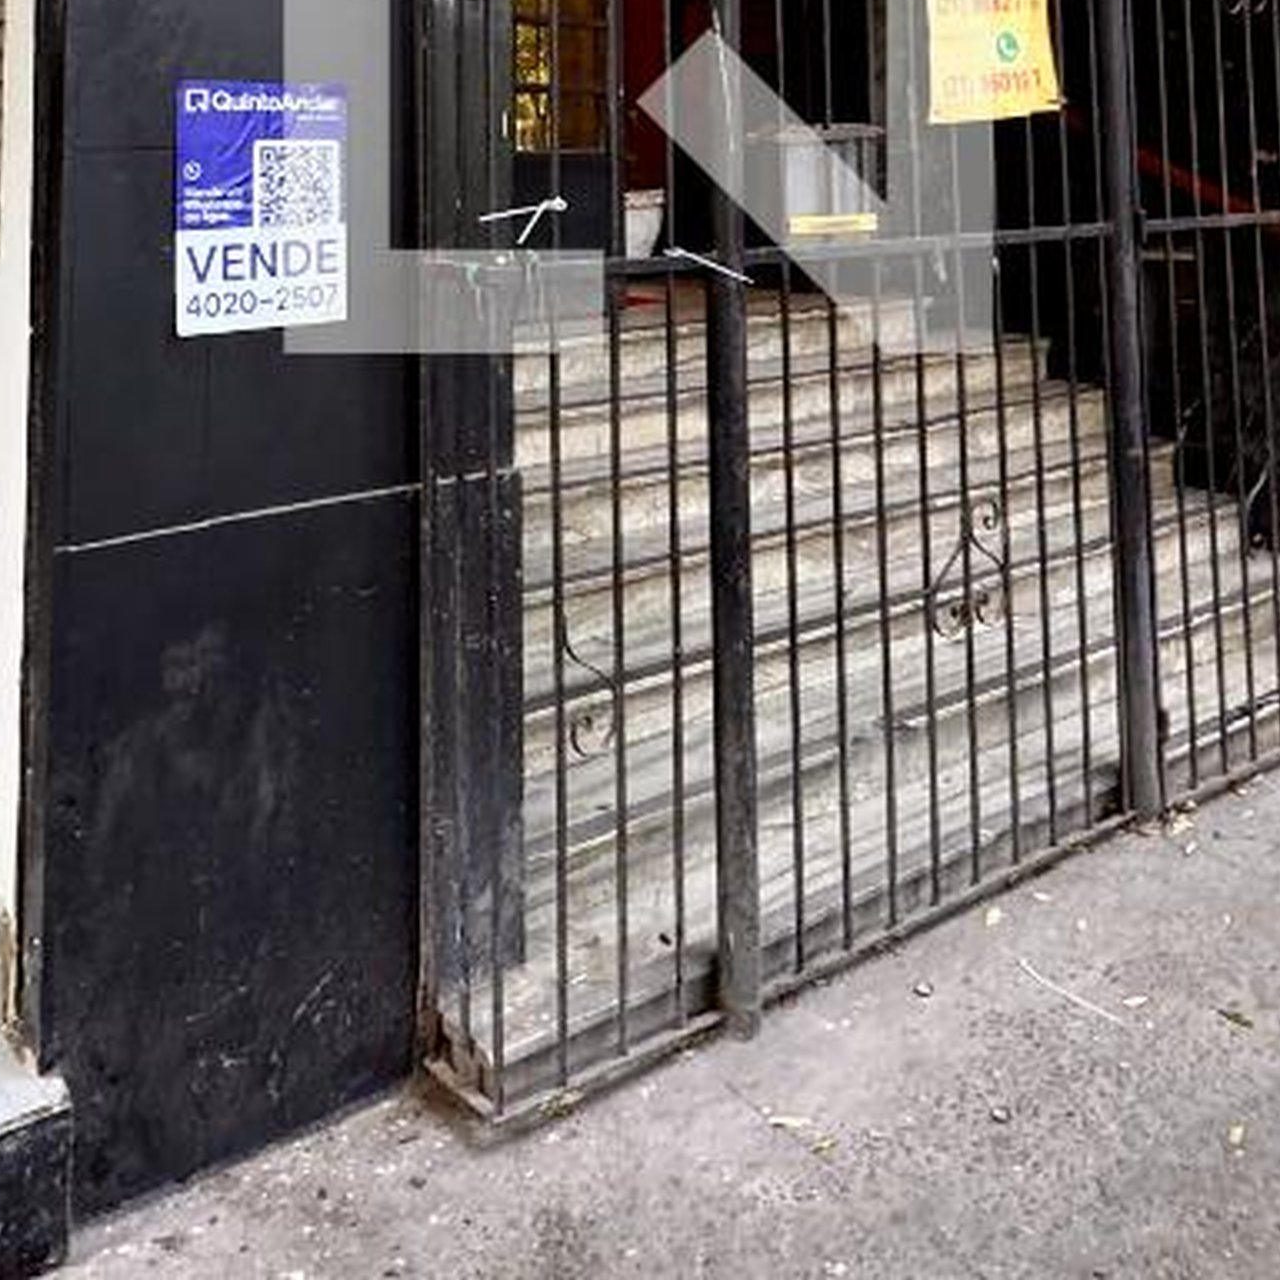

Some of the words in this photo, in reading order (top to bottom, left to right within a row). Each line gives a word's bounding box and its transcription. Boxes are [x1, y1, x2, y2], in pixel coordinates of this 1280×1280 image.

[212, 89, 338, 112] QuintoAnd
[186, 238, 339, 284] VENDE
[186, 283, 339, 318] 4020-2507
